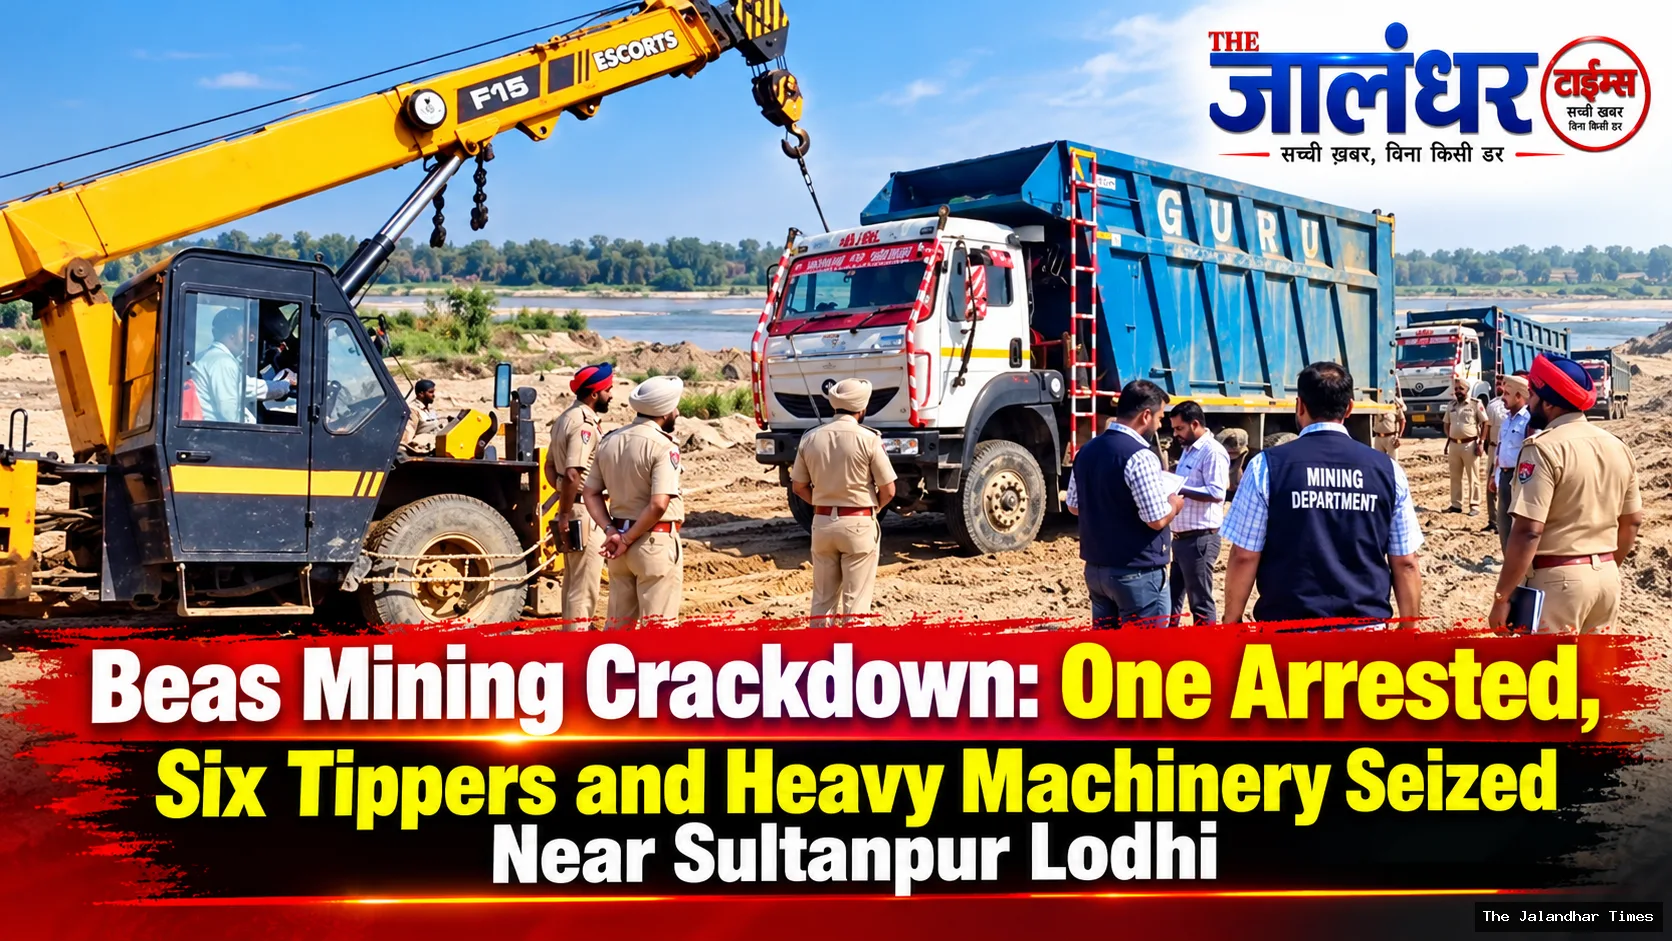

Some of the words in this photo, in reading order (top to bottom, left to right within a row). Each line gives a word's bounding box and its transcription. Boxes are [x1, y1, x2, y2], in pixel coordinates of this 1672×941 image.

[592, 29, 679, 72] ESCORTS
[468, 75, 529, 111] F15
[1157, 188, 1320, 259] GURU
[1306, 467, 1364, 489] MINING
[1291, 491, 1378, 512] DEPARTMENT
